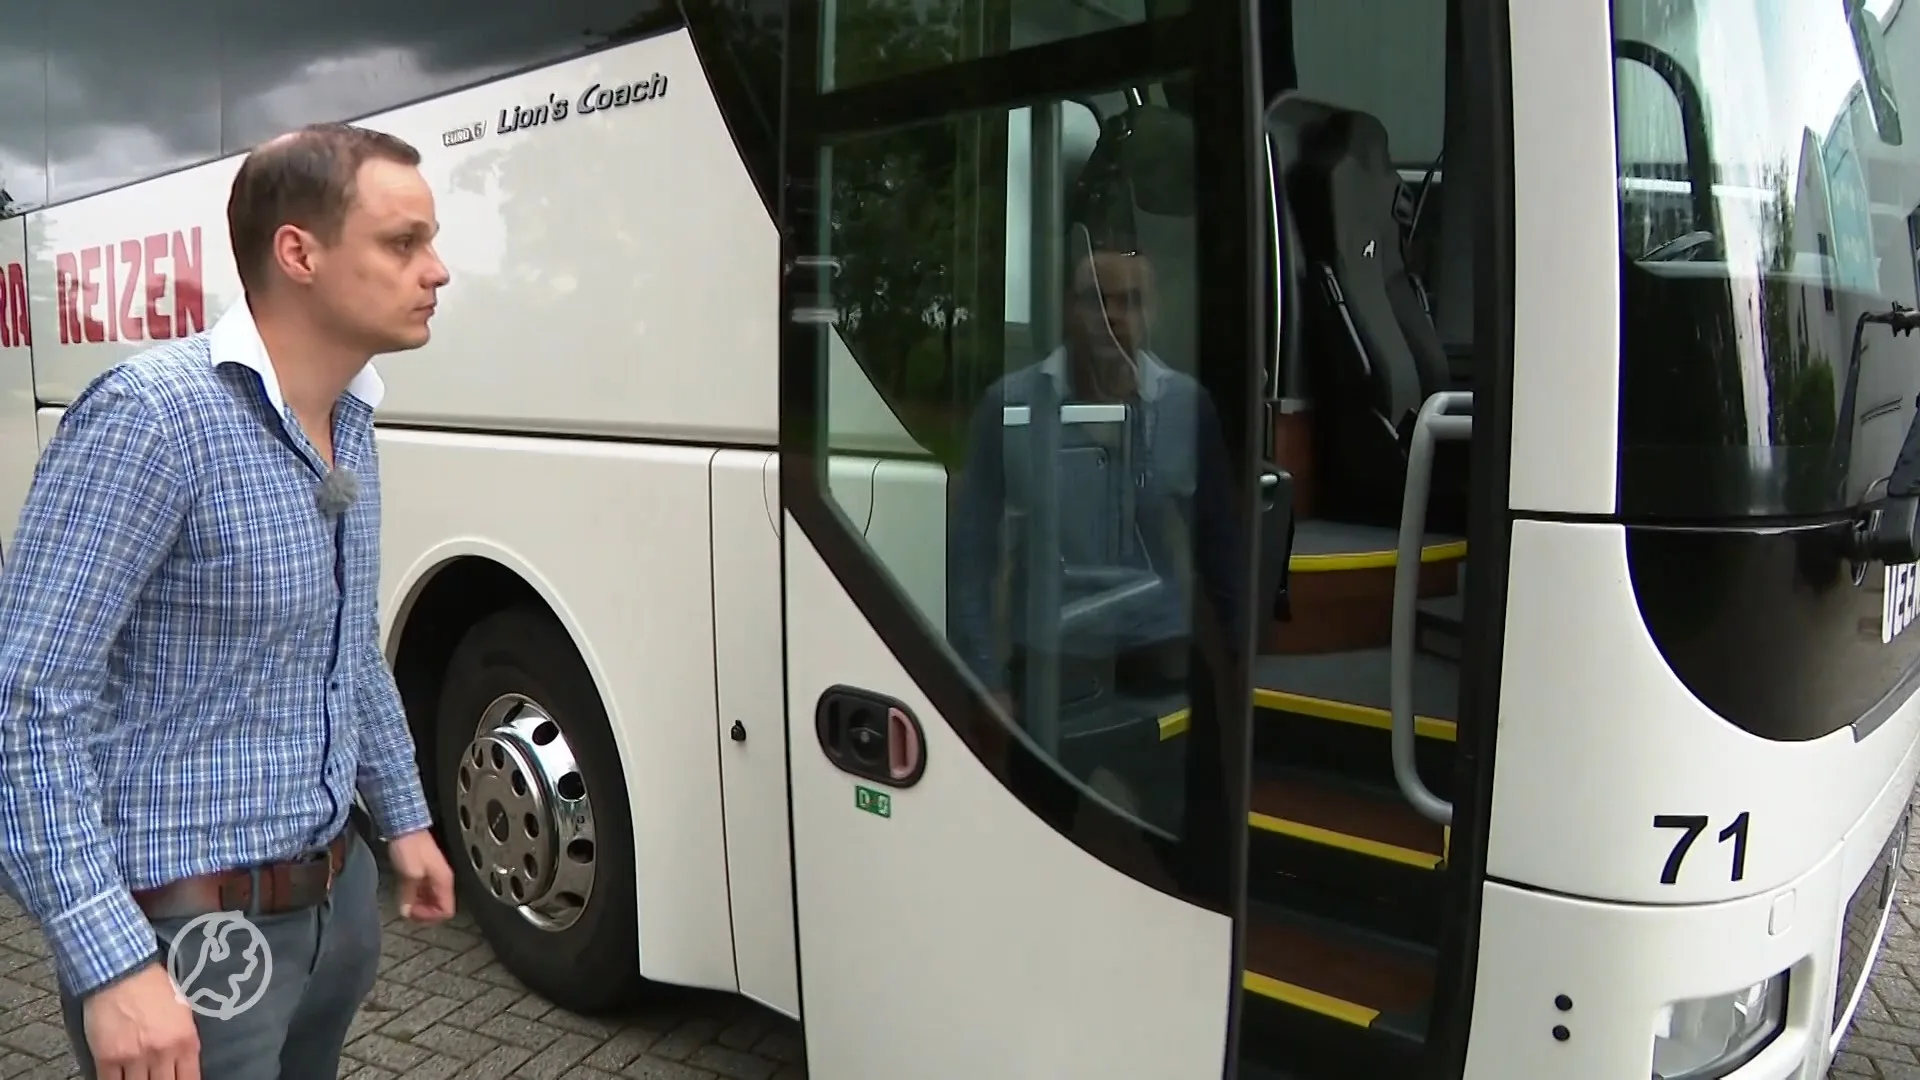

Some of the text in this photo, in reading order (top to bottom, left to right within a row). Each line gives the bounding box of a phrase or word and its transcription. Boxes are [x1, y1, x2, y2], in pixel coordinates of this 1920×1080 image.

[497, 72, 668, 135] Lion's Coach
[56, 226, 204, 344] REIZEN
[1653, 811, 1750, 884] 71
